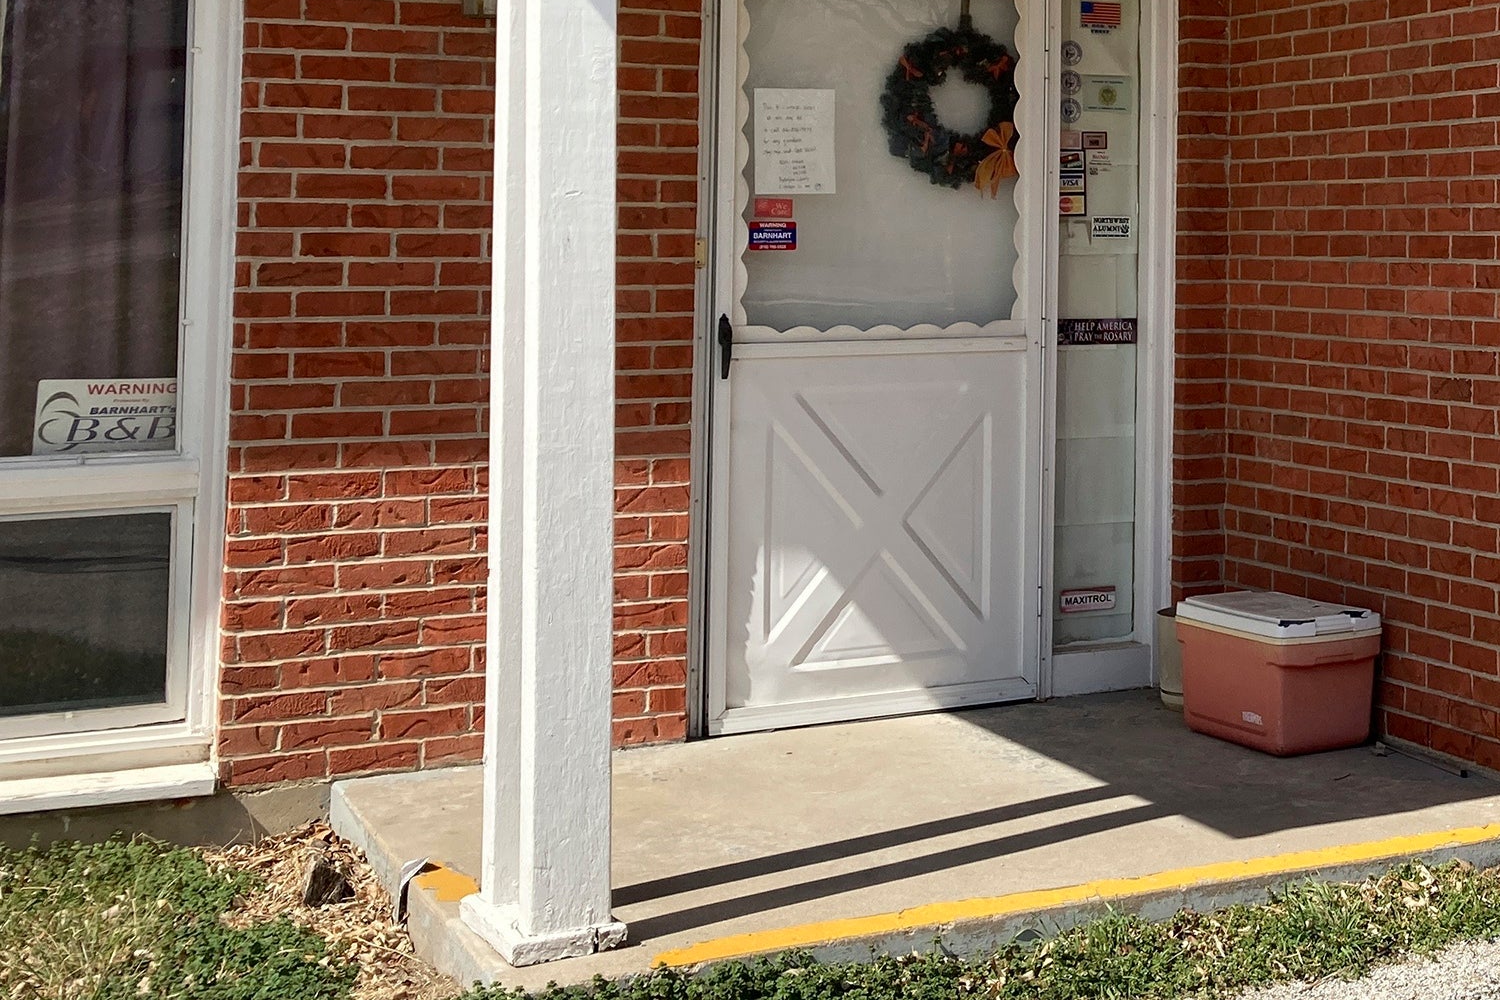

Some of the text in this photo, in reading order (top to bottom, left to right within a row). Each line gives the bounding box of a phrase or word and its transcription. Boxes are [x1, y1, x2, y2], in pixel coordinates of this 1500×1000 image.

[1074, 321, 1133, 331] HELP AMERICA
[1074, 332, 1093, 342] PRAY
[1103, 331, 1133, 341] ROSARY
[87, 383, 177, 395] WARNING
[1064, 594, 1112, 606] MAXITROL
